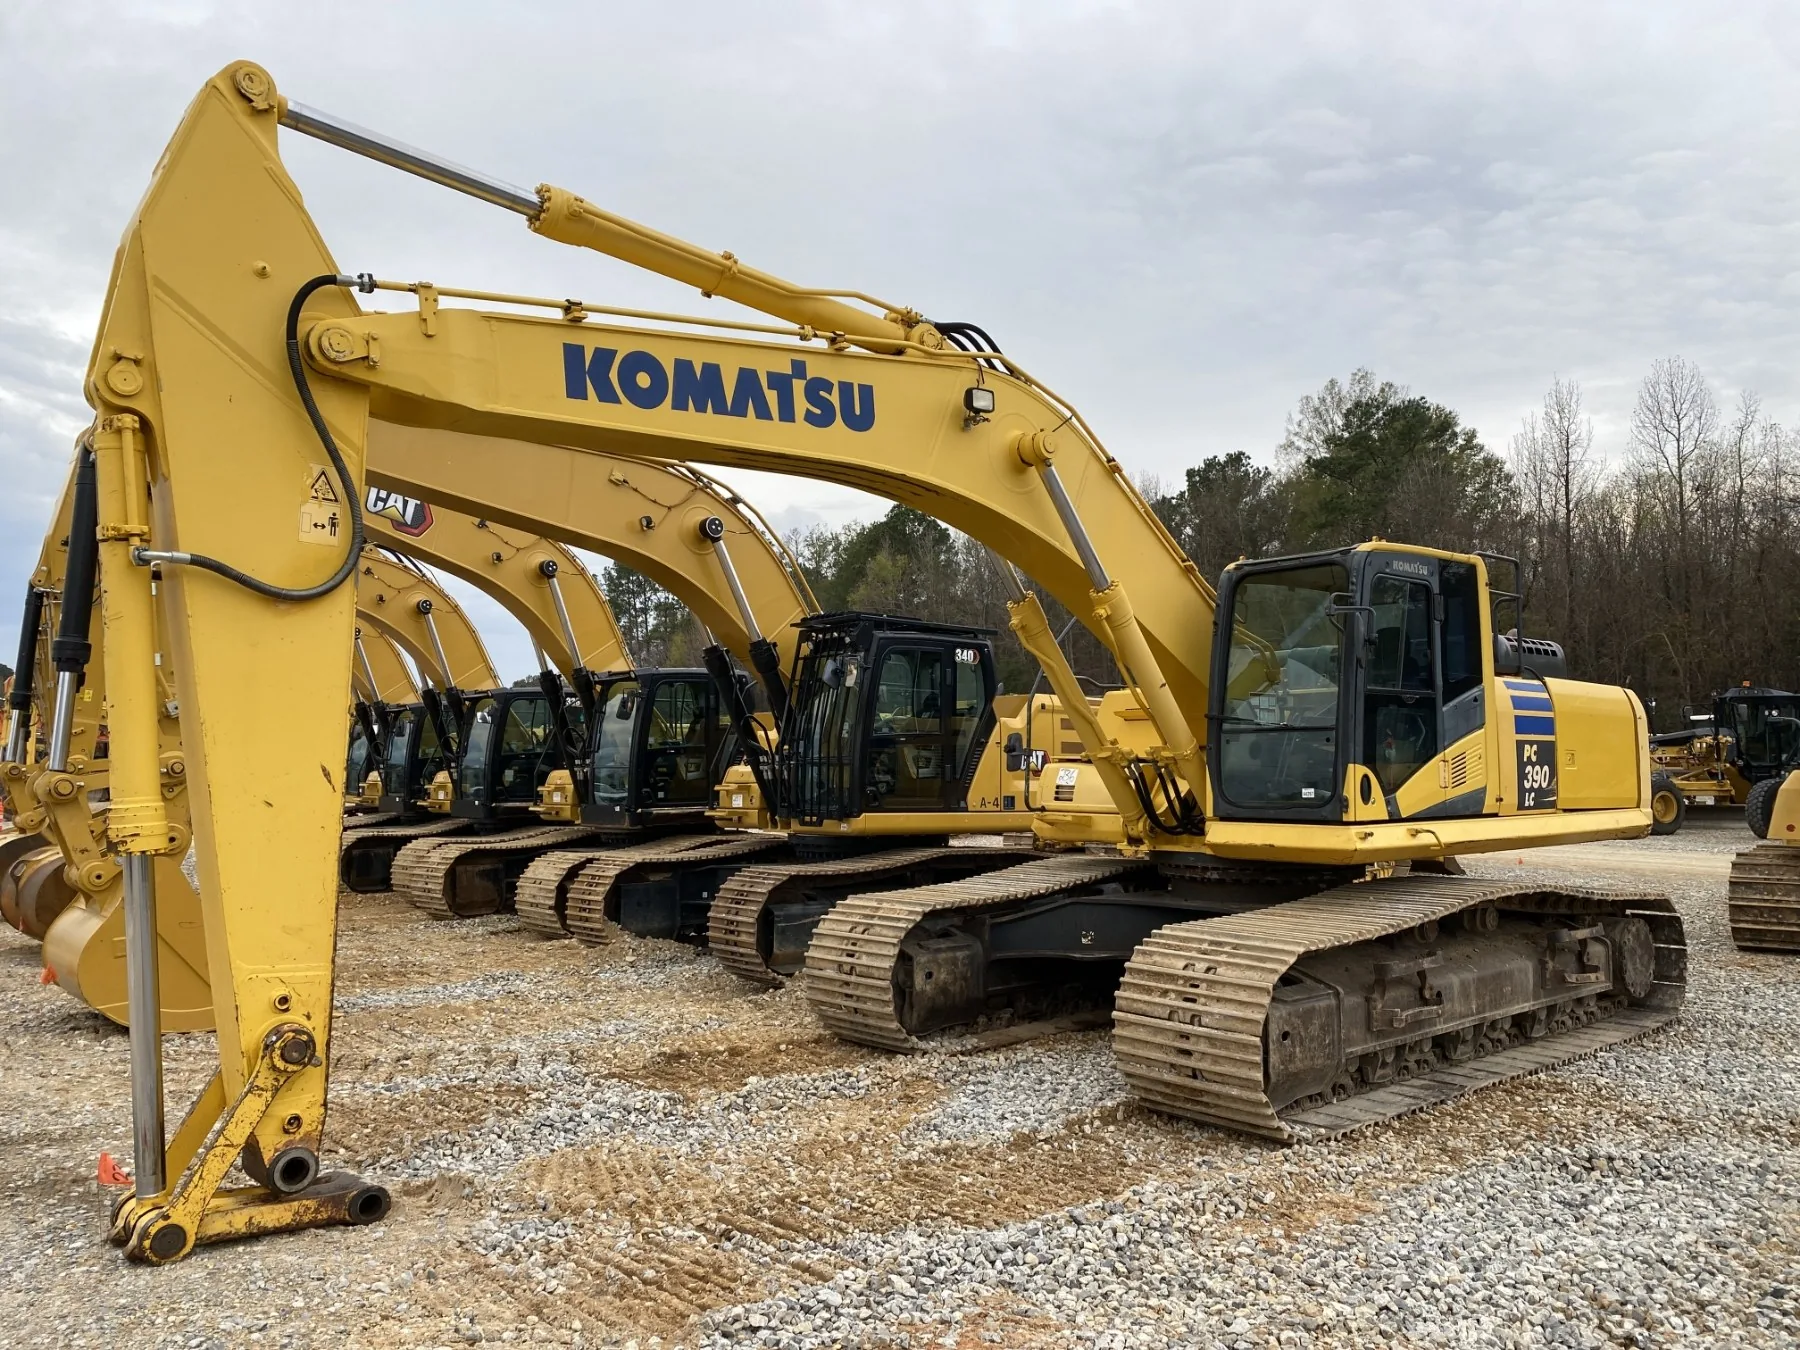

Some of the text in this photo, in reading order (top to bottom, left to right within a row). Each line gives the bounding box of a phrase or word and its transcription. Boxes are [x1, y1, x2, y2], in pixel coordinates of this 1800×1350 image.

[562, 342, 876, 432] KOMATSU
[366, 486, 421, 525] CAT
[1392, 560, 1428, 576] KOMATSU
[955, 648, 974, 662] 340
[1524, 744, 1538, 762] PC
[1524, 765, 1550, 789] 390
[980, 796, 1000, 809] A-4
[1524, 792, 1535, 807] LC
